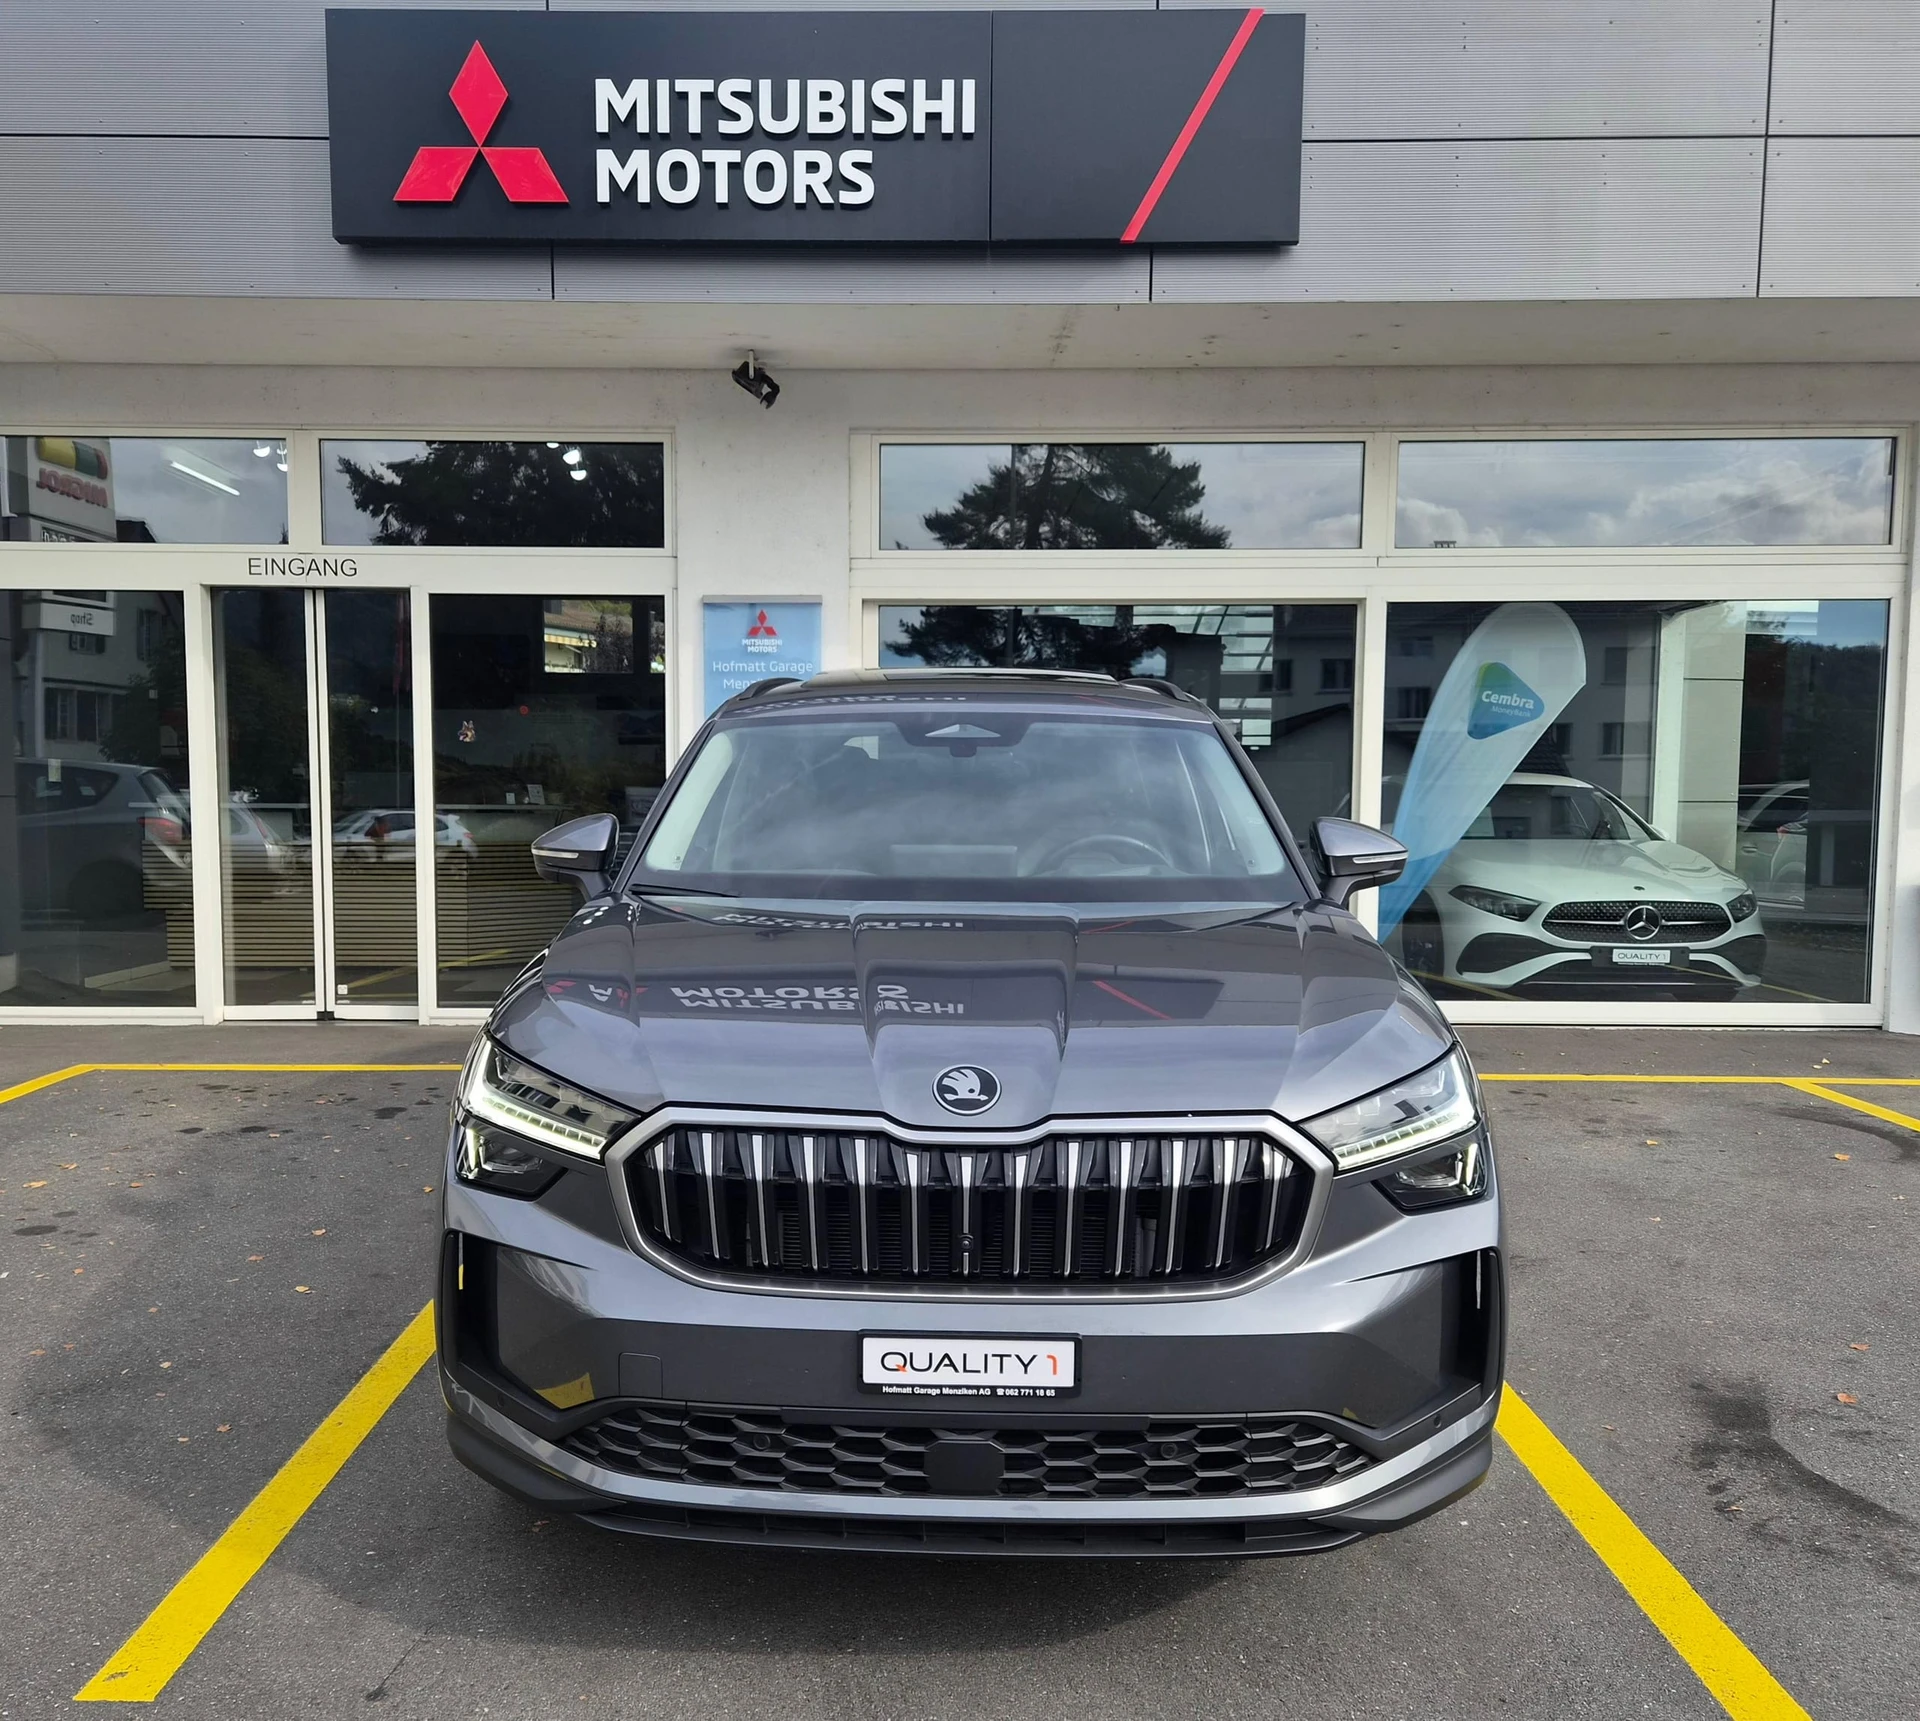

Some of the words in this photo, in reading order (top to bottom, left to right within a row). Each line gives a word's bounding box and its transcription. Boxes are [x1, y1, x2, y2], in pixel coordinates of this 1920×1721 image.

[594, 78, 976, 134] MITSUBISHI
[595, 148, 875, 205] MOTORS
[248, 557, 358, 577] EINGANG
[712, 661, 766, 672] Hofmatt
[769, 661, 813, 674] Garage
[1482, 691, 1534, 709] Cembra
[1617, 952, 1660, 960] QUALITY
[880, 1351, 1038, 1375] QUALITY
[1046, 1354, 1058, 1376] 1
[882, 1386, 912, 1394] Hofmatt
[914, 1387, 941, 1396] Garage
[942, 1387, 977, 1395] Menziken
